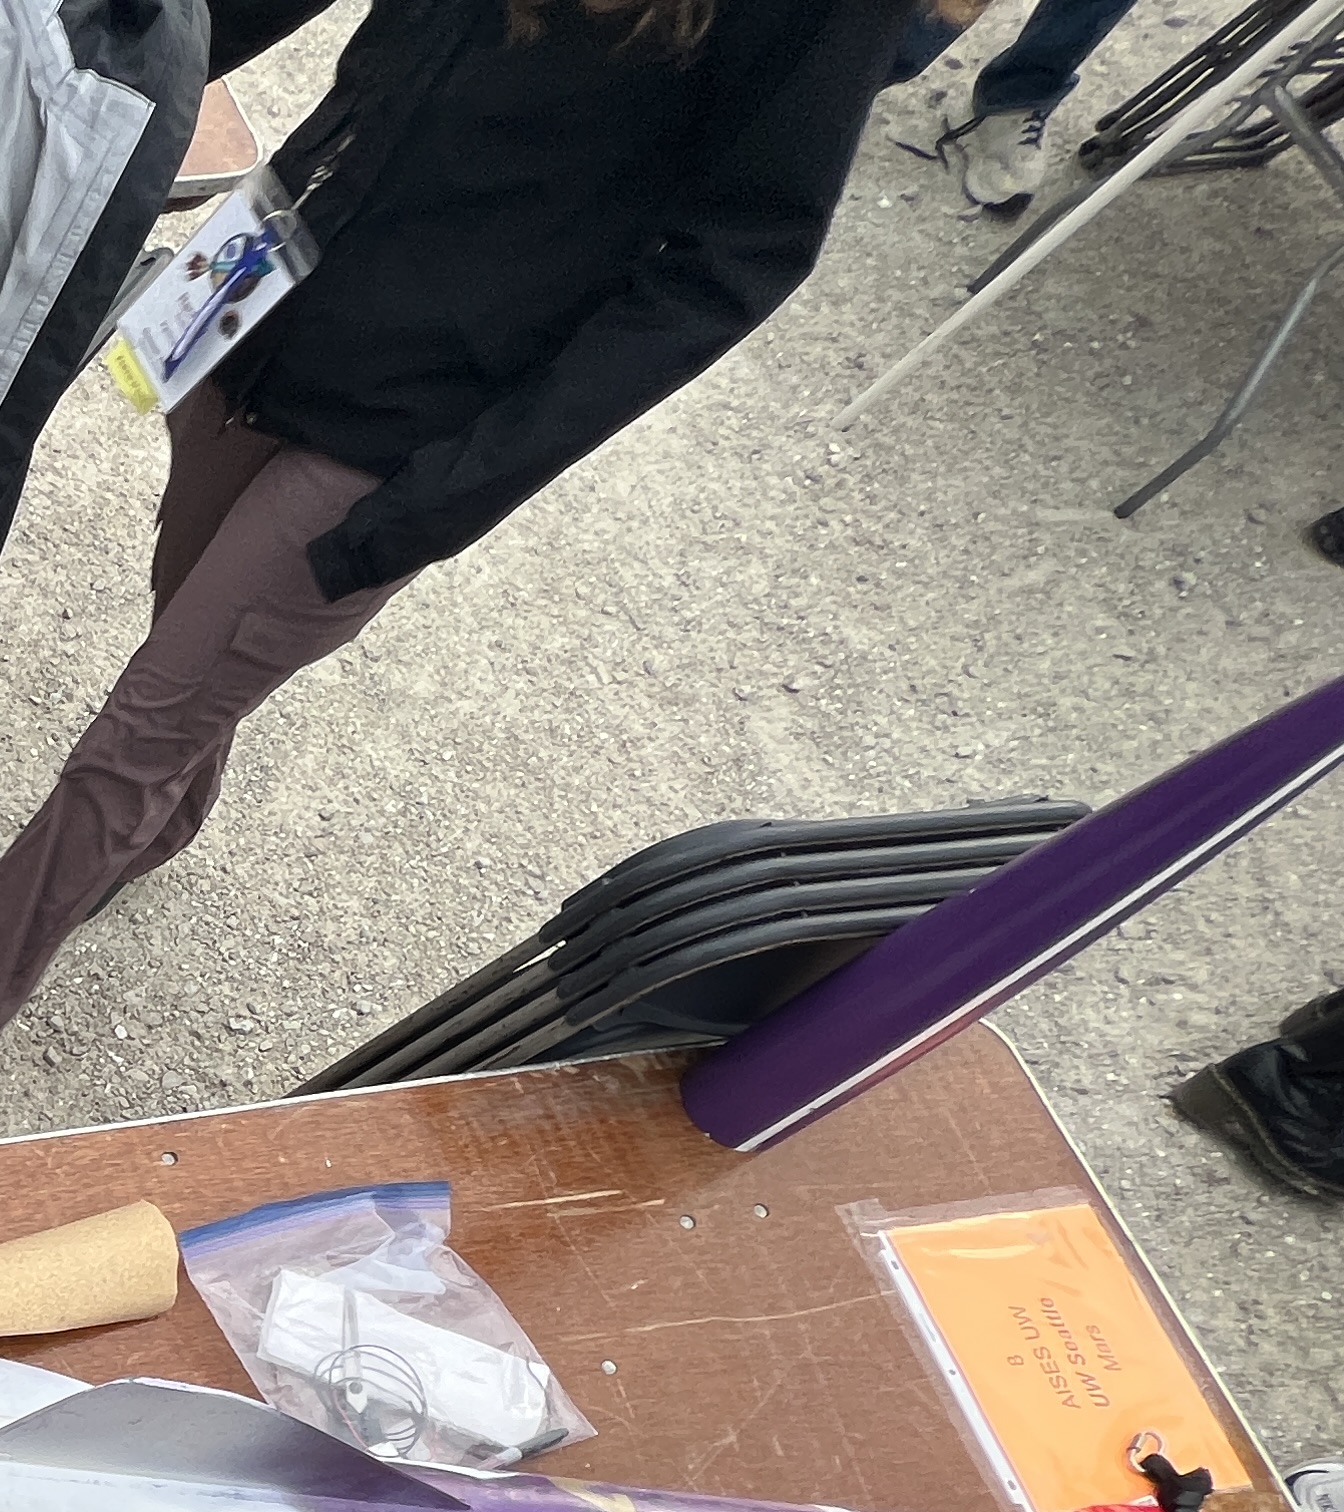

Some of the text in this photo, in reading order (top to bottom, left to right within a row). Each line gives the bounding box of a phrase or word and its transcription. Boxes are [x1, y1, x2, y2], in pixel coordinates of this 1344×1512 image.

[1008, 1305, 1082, 1409] AISES UW
[1085, 1324, 1123, 1372] Mars
[1075, 1371, 1111, 1407] UW
